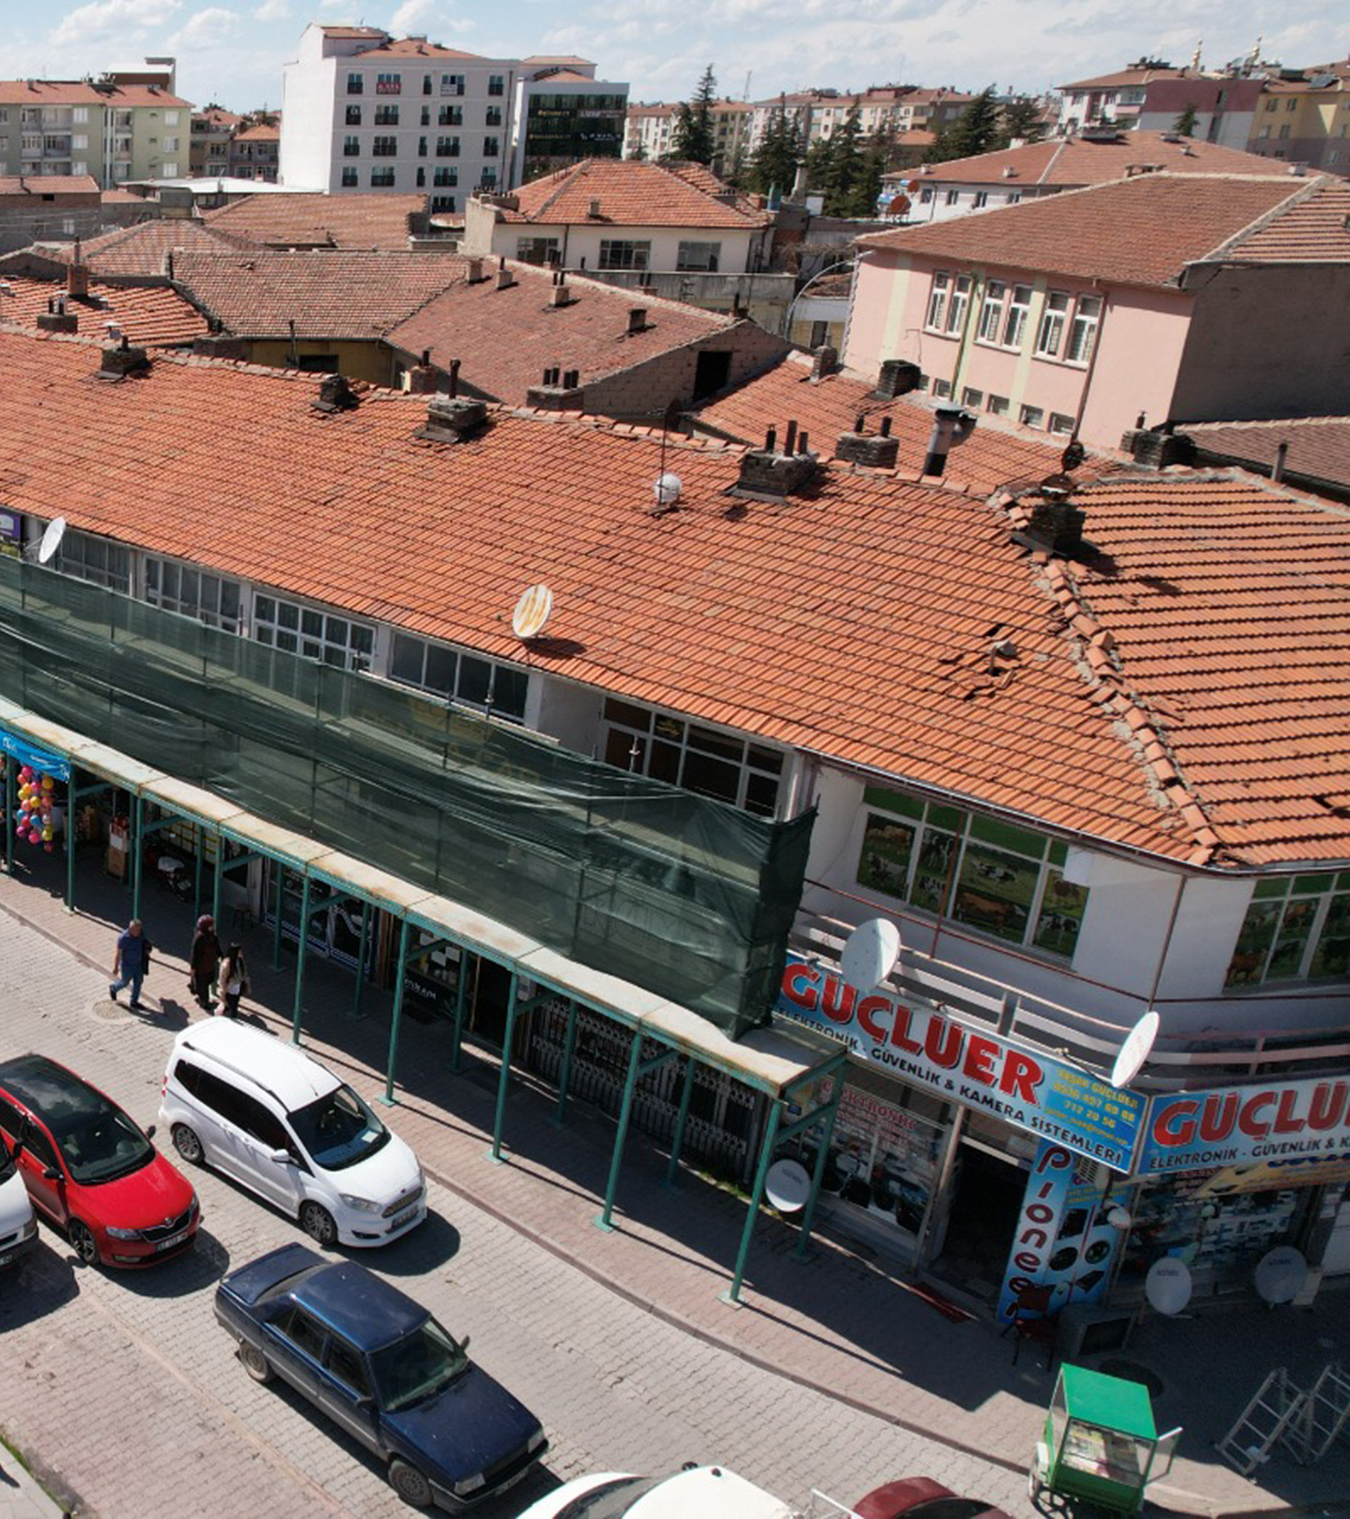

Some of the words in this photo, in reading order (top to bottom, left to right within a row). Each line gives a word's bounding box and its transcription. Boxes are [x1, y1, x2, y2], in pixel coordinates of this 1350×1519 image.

[871, 1047, 941, 1086] GÜVENLİK
[944, 1079, 954, 1091] &
[959, 1085, 1025, 1122] KAMERA
[1153, 1081, 1350, 1147] GÜÇLÜ
[1150, 1146, 1239, 1169] ELEKTRONİK
[1251, 1137, 1322, 1157] GÜVENLİK
[1324, 1137, 1335, 1149] &
